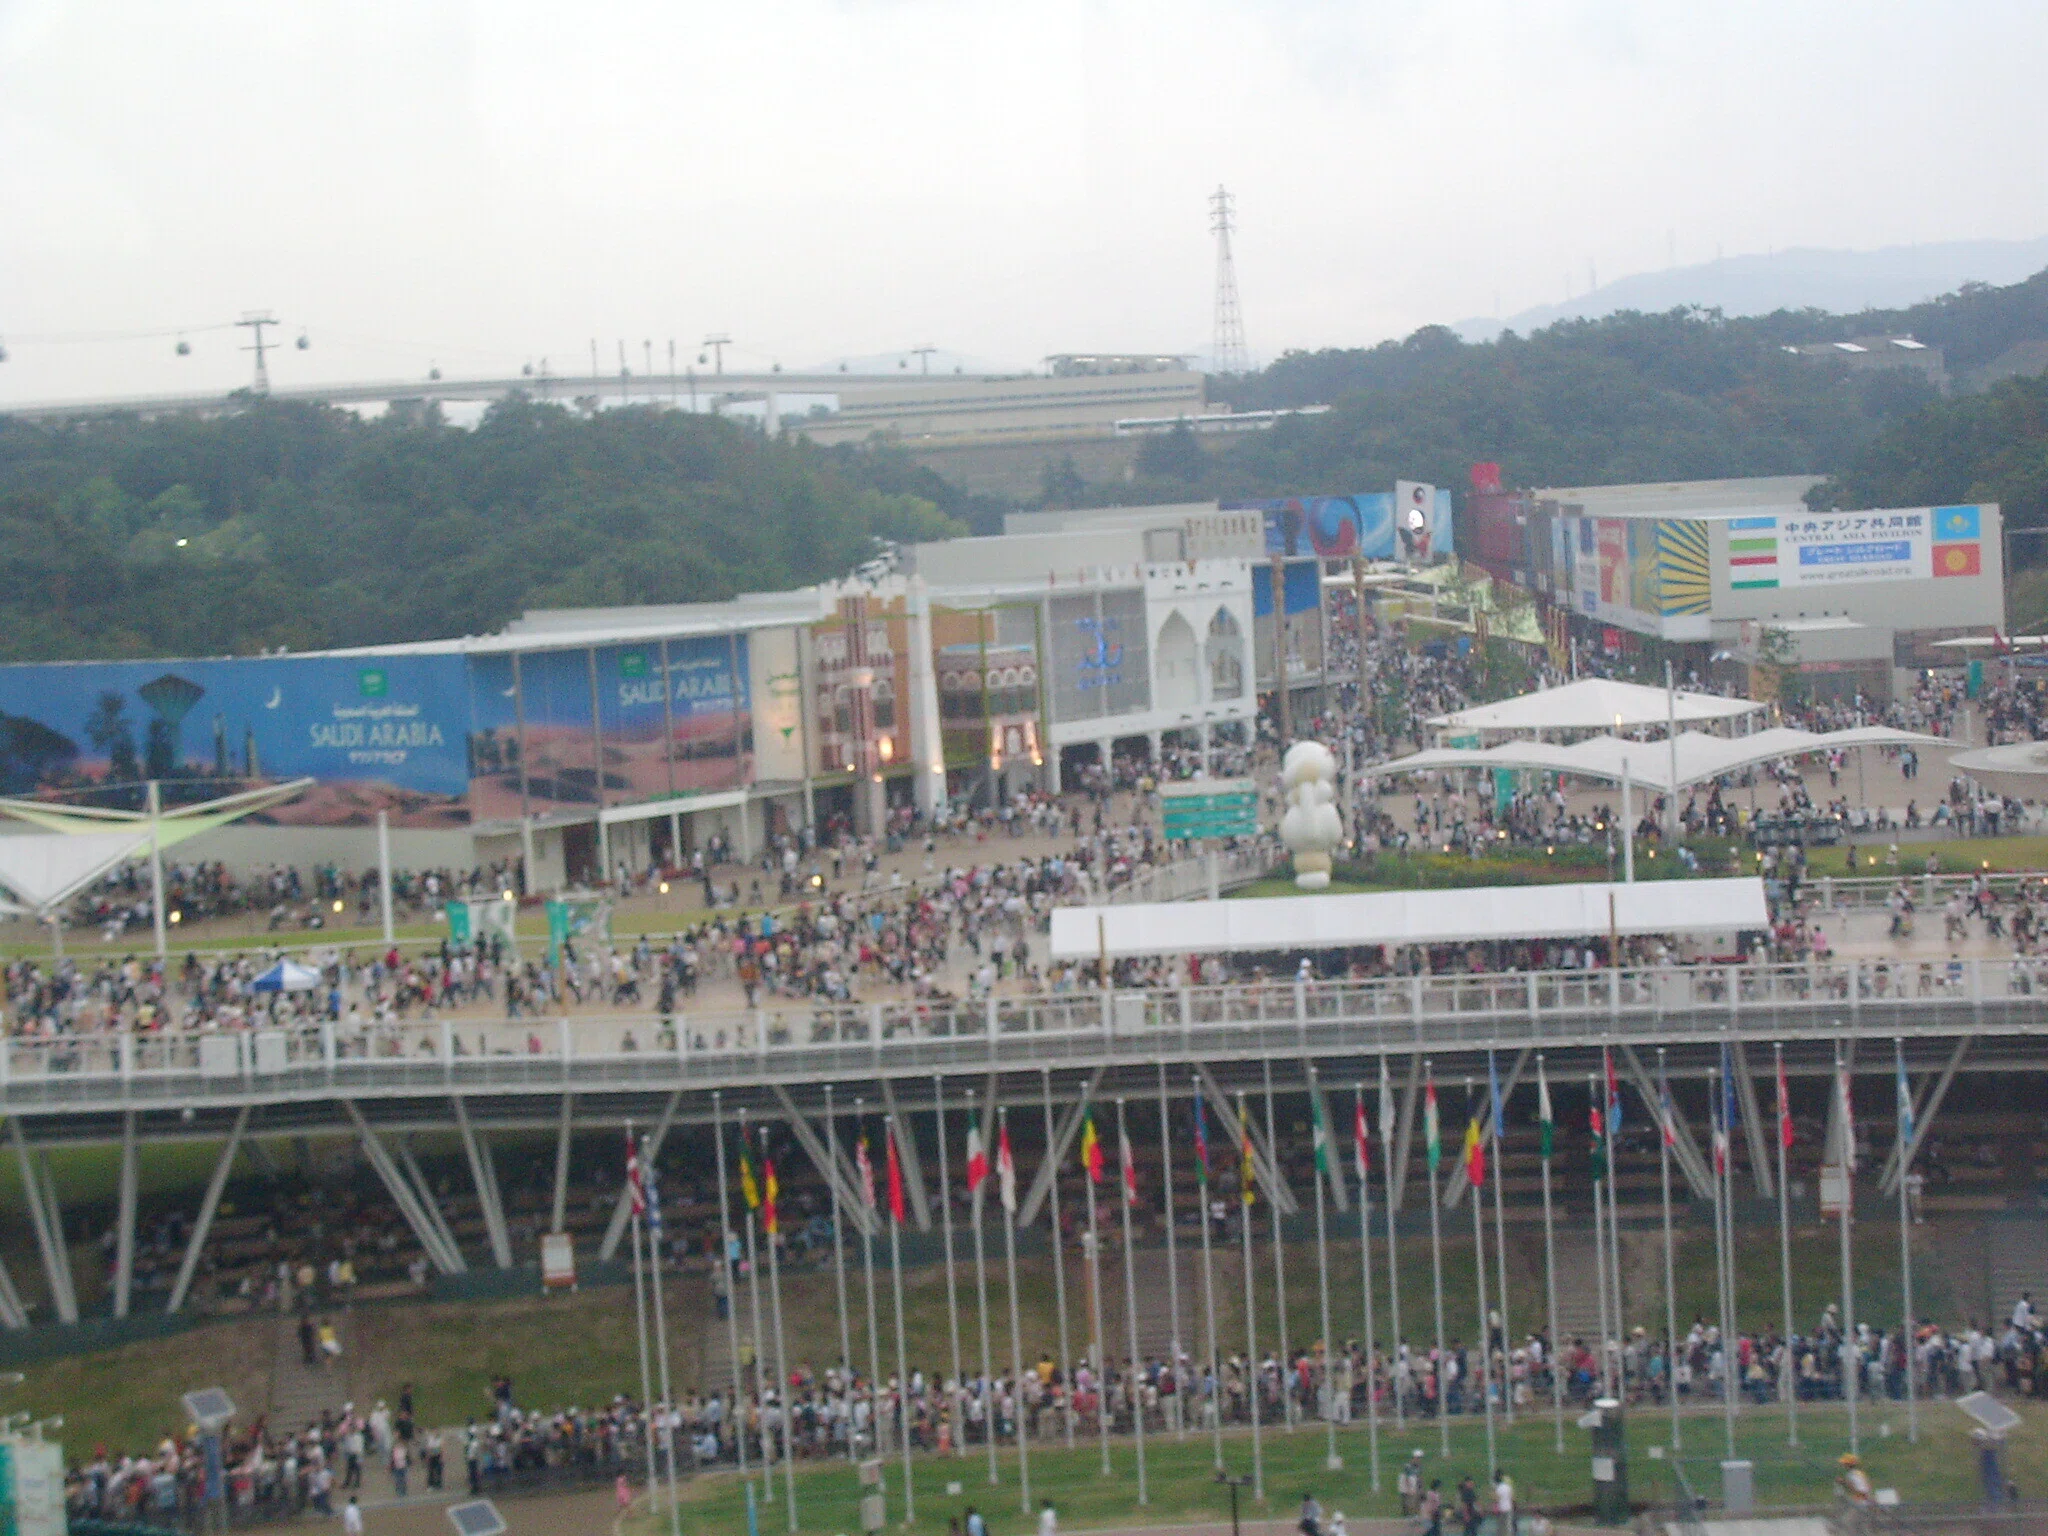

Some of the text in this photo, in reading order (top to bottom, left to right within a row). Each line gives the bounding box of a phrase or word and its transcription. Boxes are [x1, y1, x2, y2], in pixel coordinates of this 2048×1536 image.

[1785, 515, 1922, 533] 中央アジア共同館
[1785, 529, 1923, 542] CENTRAL ASIA PAVILION
[310, 722, 445, 747] SAUDI ARABIA
